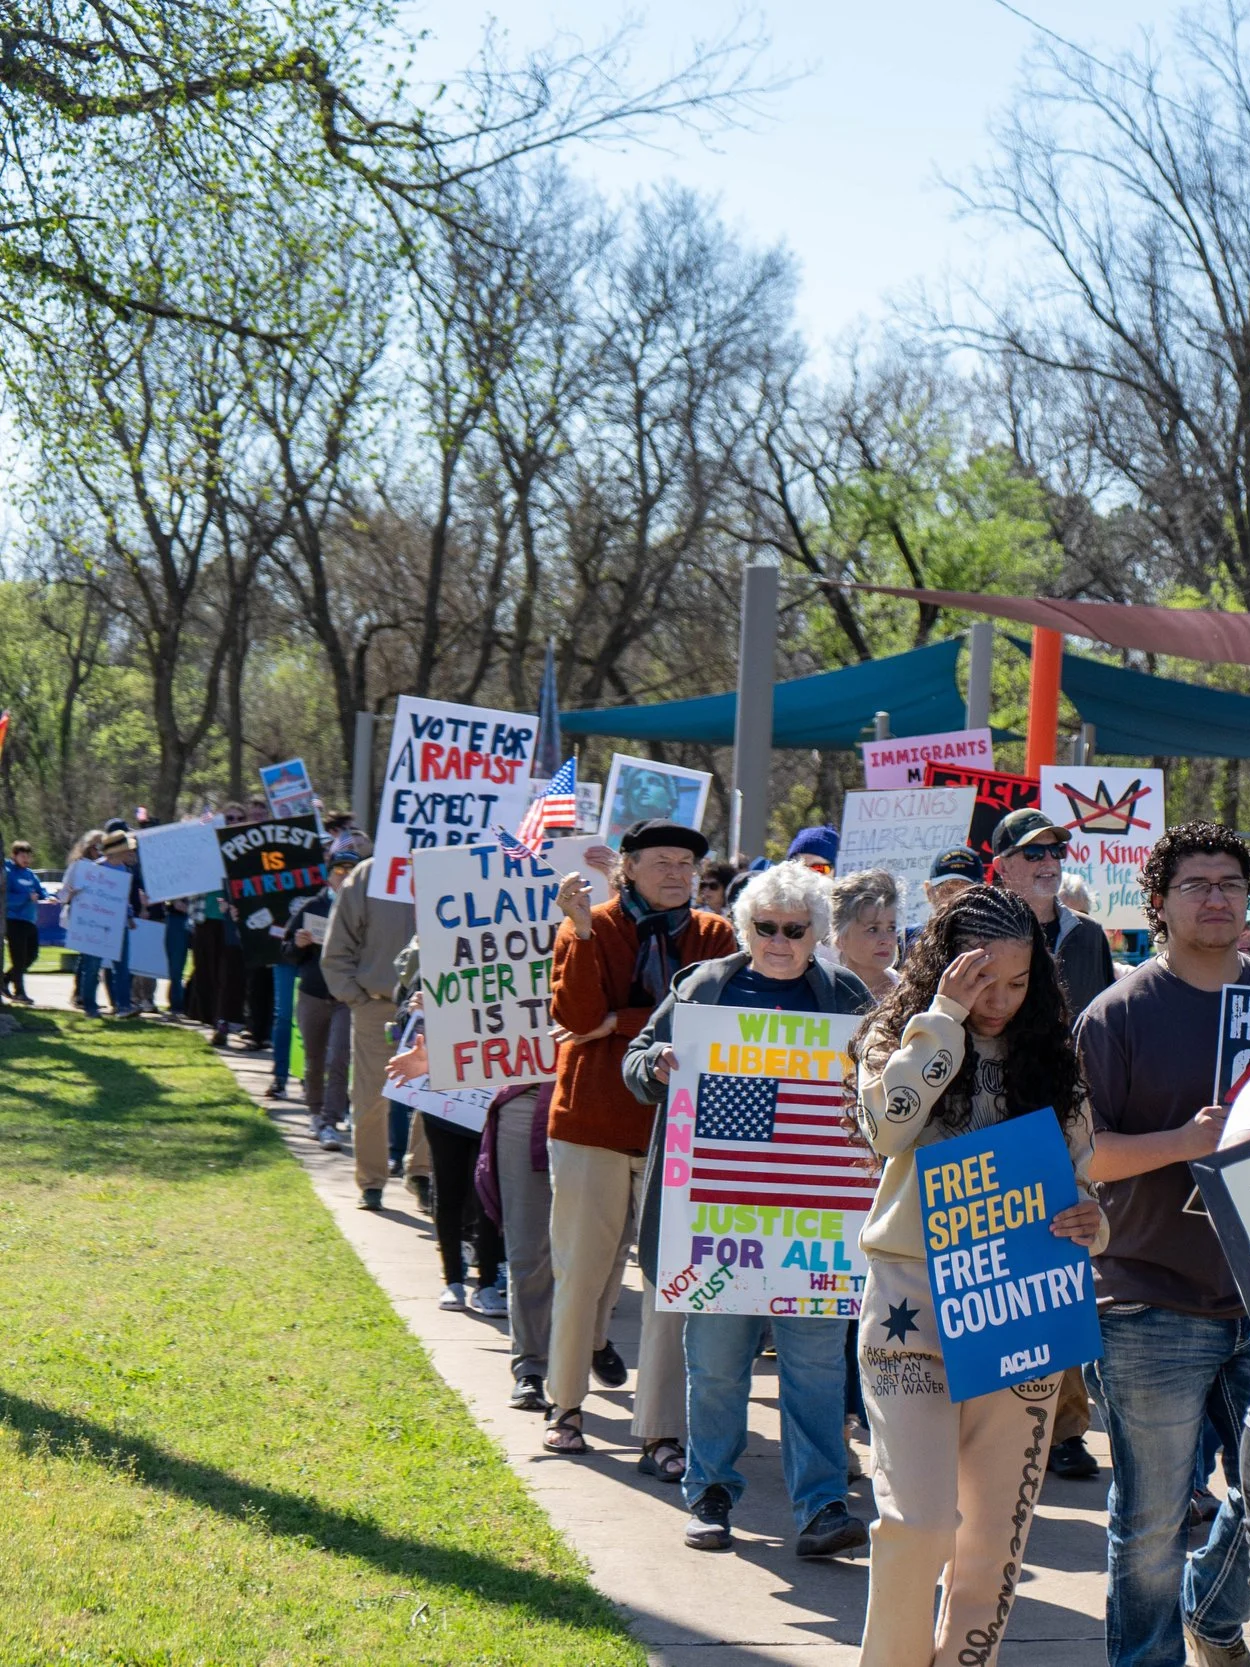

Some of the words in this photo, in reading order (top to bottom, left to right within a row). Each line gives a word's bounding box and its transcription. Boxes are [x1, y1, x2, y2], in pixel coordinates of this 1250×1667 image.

[410, 712, 488, 752] VOTE
[491, 723, 533, 760] FOR
[870, 739, 988, 768] IMMIGRANTS
[390, 736, 416, 783] A
[390, 789, 499, 829] EXPECT
[857, 796, 891, 822] NO
[892, 791, 960, 820] KINGS
[221, 824, 319, 860] PROTEST
[470, 841, 556, 881] THE
[1105, 863, 1136, 886] the
[230, 863, 328, 900] PATRIOTIC!
[1105, 883, 1149, 920] pleas
[453, 918, 557, 967] ABOU
[422, 964, 519, 1008] VOTER
[472, 1003, 504, 1035] IS
[737, 1013, 831, 1047] WITH
[453, 1034, 560, 1084] FRAU
[663, 1087, 697, 1188] AND
[923, 1150, 1001, 1209] FREE
[691, 1203, 845, 1240] JUSTICE
[928, 1182, 1047, 1252] SPEECH
[691, 1236, 764, 1270] FOR
[781, 1240, 852, 1273] ALL
[933, 1238, 1011, 1296] FREE
[660, 1263, 700, 1305] NOT
[688, 1262, 735, 1312] JUST
[809, 1272, 867, 1293] WHIT
[940, 1260, 1086, 1341] COUNTRY
[903, 1361, 922, 1373] AN
[1000, 1344, 1051, 1379] ACLU
[901, 1381, 945, 1396] WAVER
[1018, 1383, 1056, 1394] CLOUT
